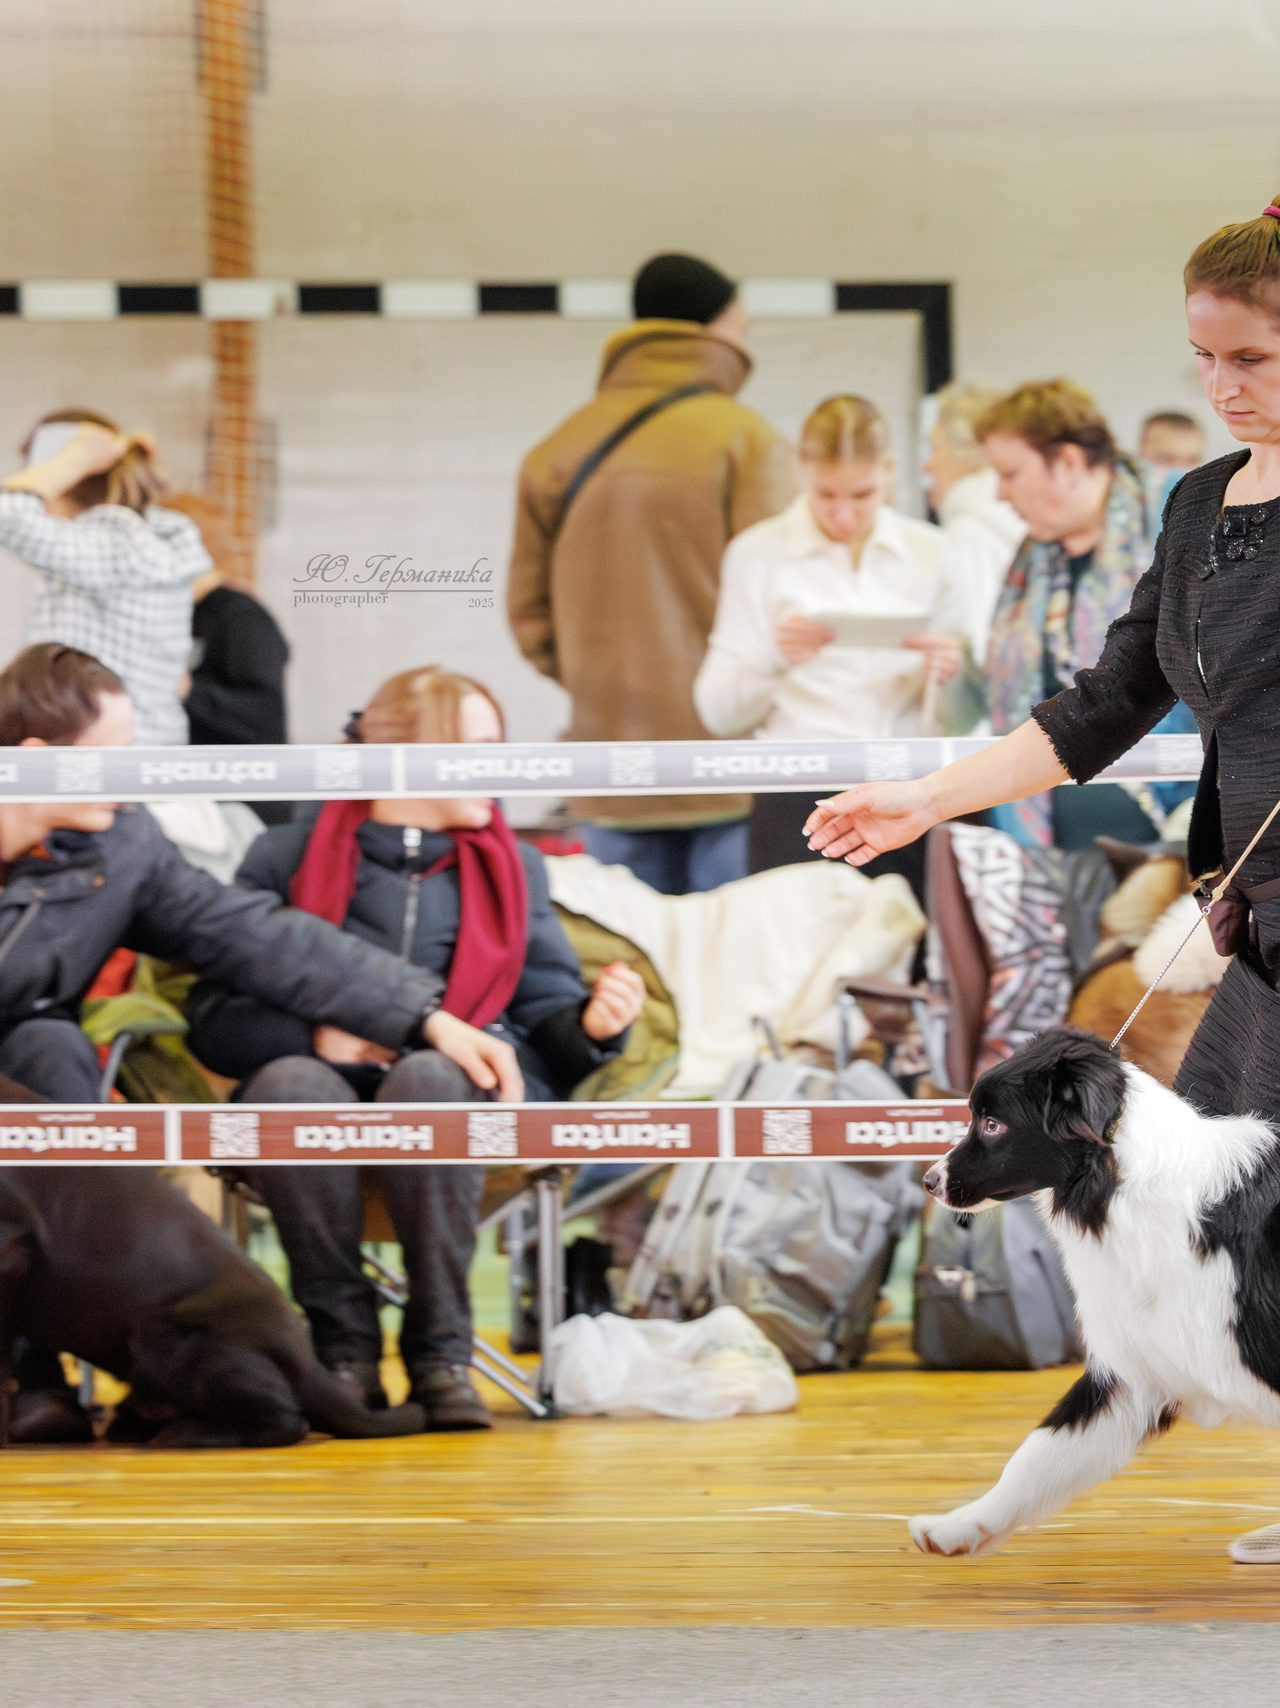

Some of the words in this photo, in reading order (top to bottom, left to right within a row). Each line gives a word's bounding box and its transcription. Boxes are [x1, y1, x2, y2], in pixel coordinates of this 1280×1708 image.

[0, 1125, 137, 1153] Hanta
[293, 1124, 434, 1152] Hanta
[551, 1122, 692, 1151] Hanta
